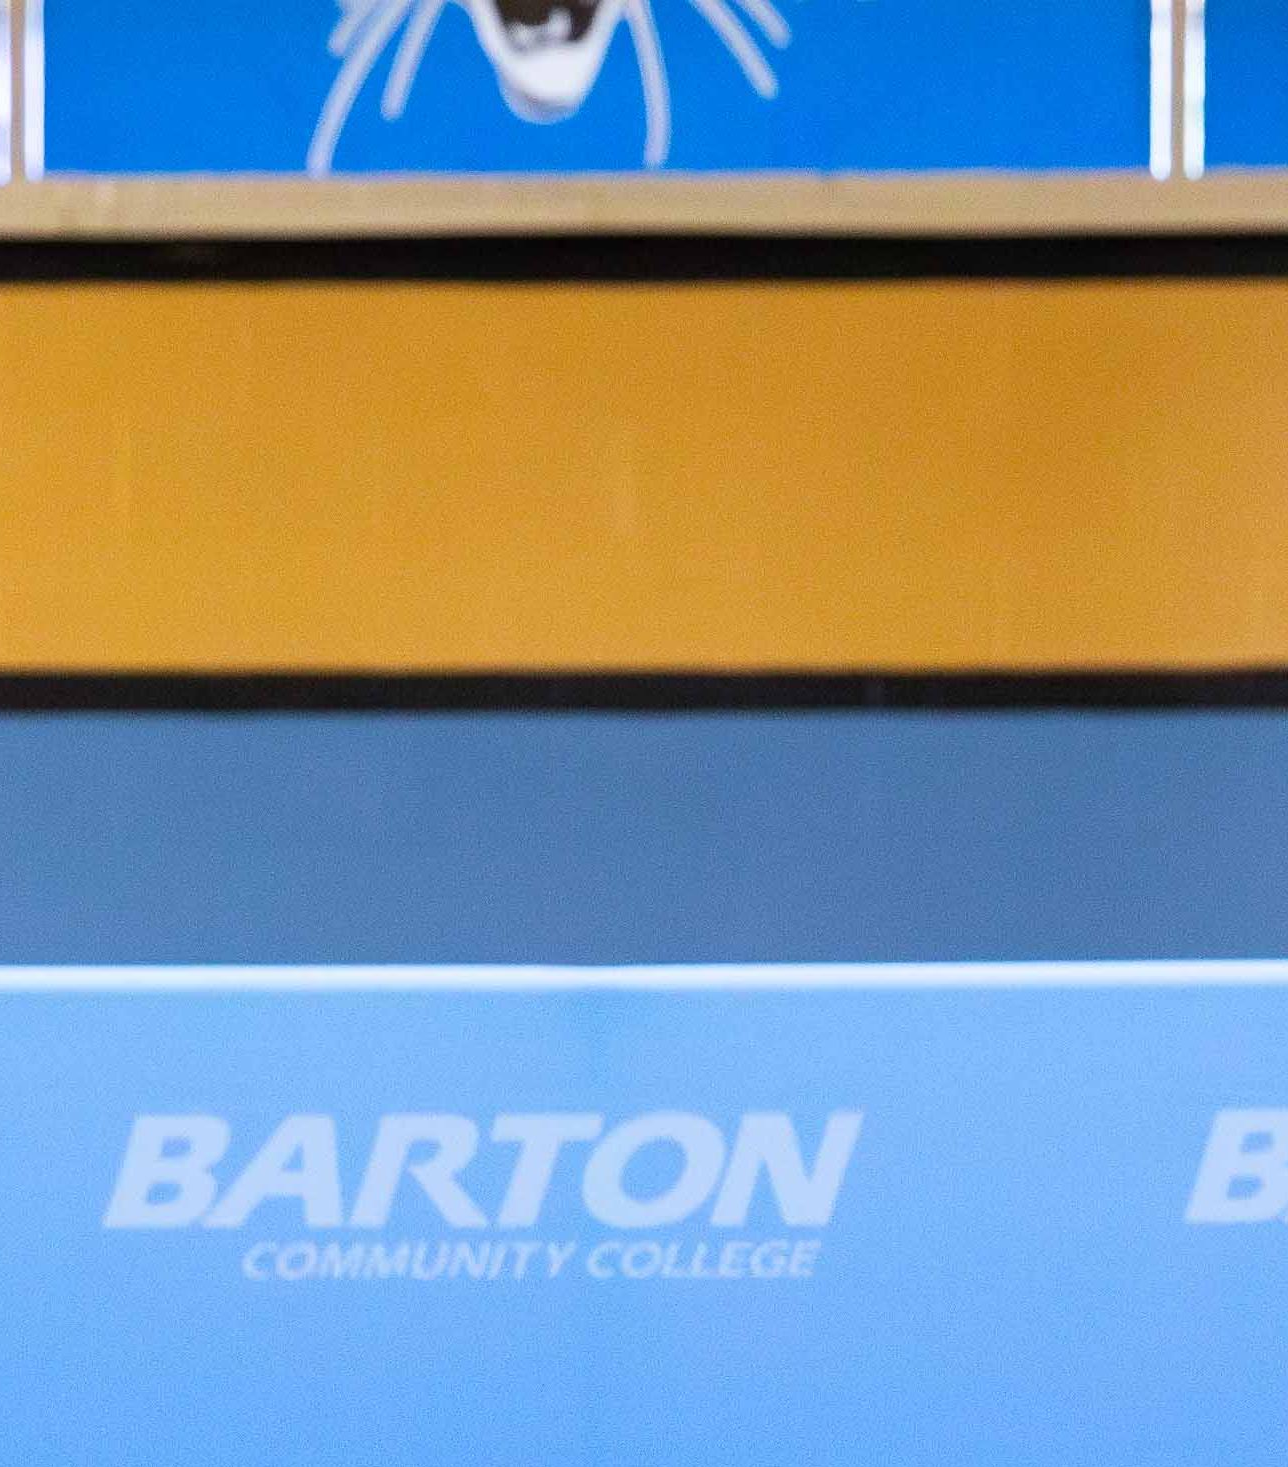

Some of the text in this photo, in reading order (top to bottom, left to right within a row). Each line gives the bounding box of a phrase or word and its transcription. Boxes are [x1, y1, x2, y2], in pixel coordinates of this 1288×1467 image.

[103, 1110, 865, 1230] BARTON
[241, 1239, 821, 1281] COMMUNITY COLLEGE
